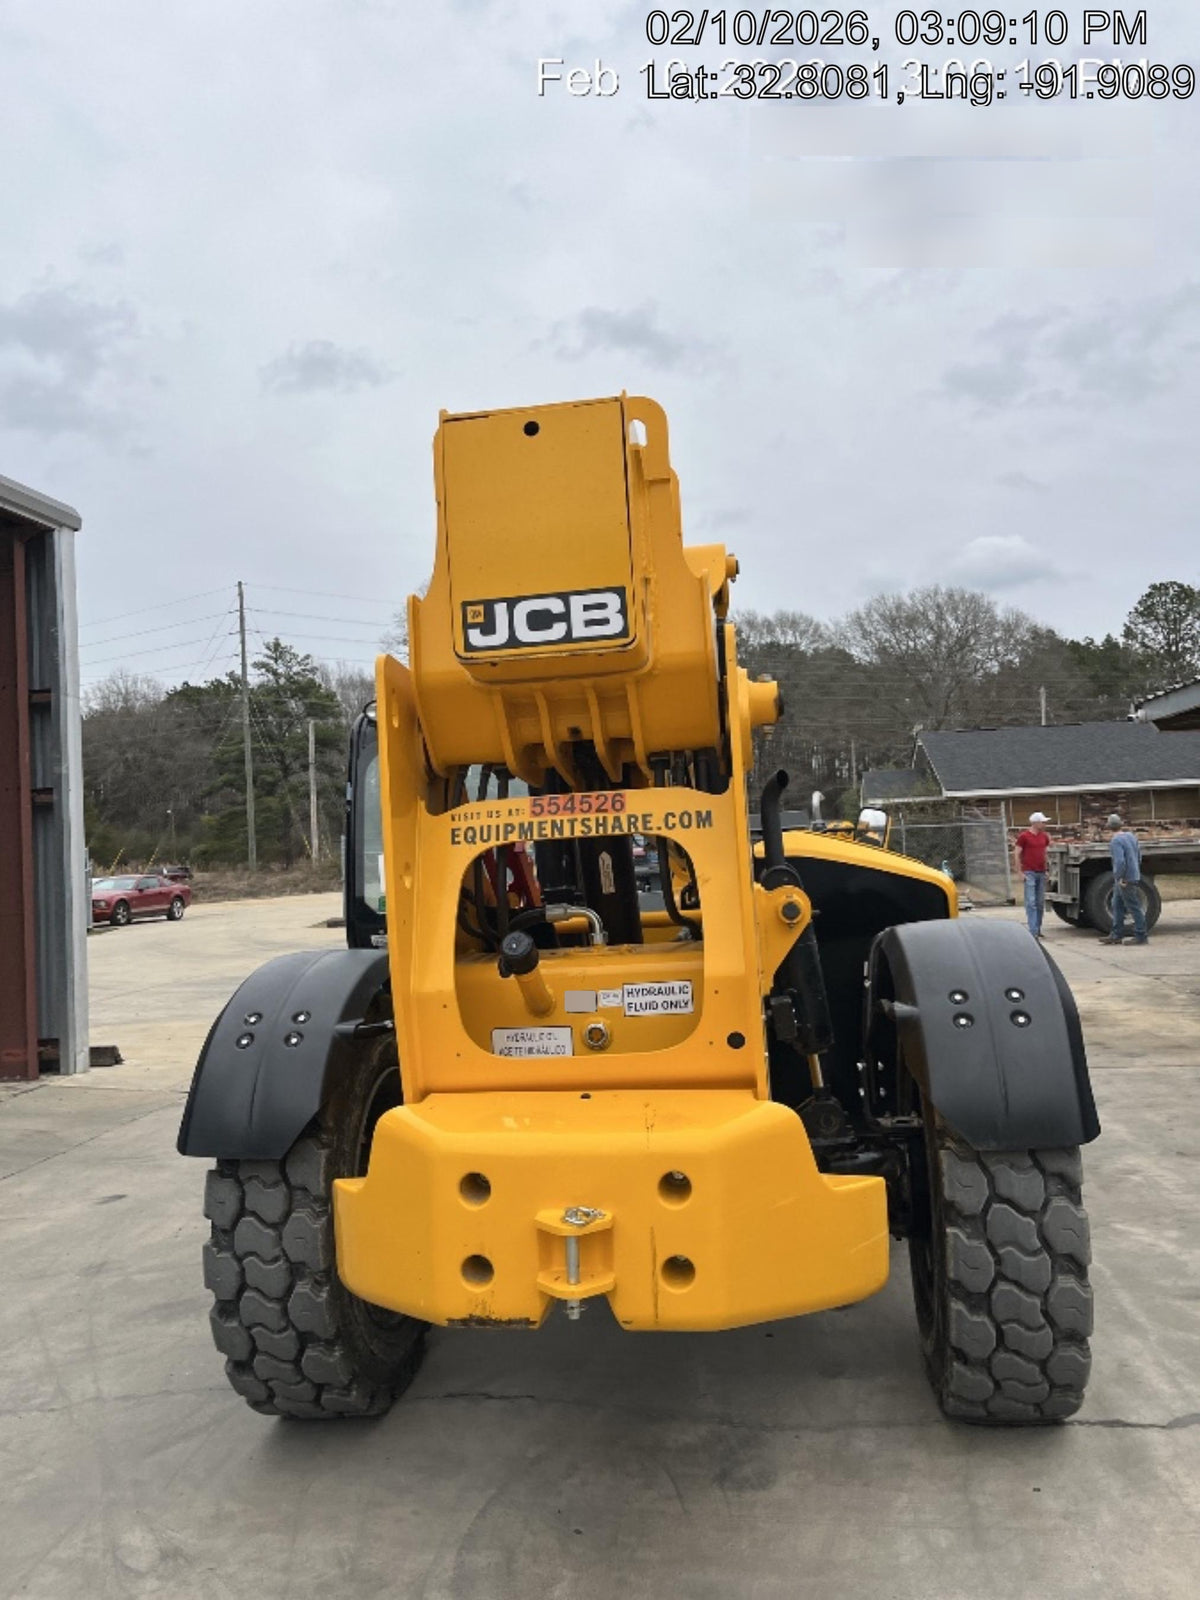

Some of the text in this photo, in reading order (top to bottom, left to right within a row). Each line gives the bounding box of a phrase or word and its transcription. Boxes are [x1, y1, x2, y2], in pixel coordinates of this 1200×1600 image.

[467, 592, 625, 647] JCB
[531, 792, 626, 817] 554526
[451, 812, 482, 822] VISIT
[487, 810, 502, 819] US
[451, 810, 714, 846] EQUIPMENTSHARE.COM
[626, 984, 690, 998] HYDRAULIC
[627, 999, 690, 1012] FLUID ONLY
